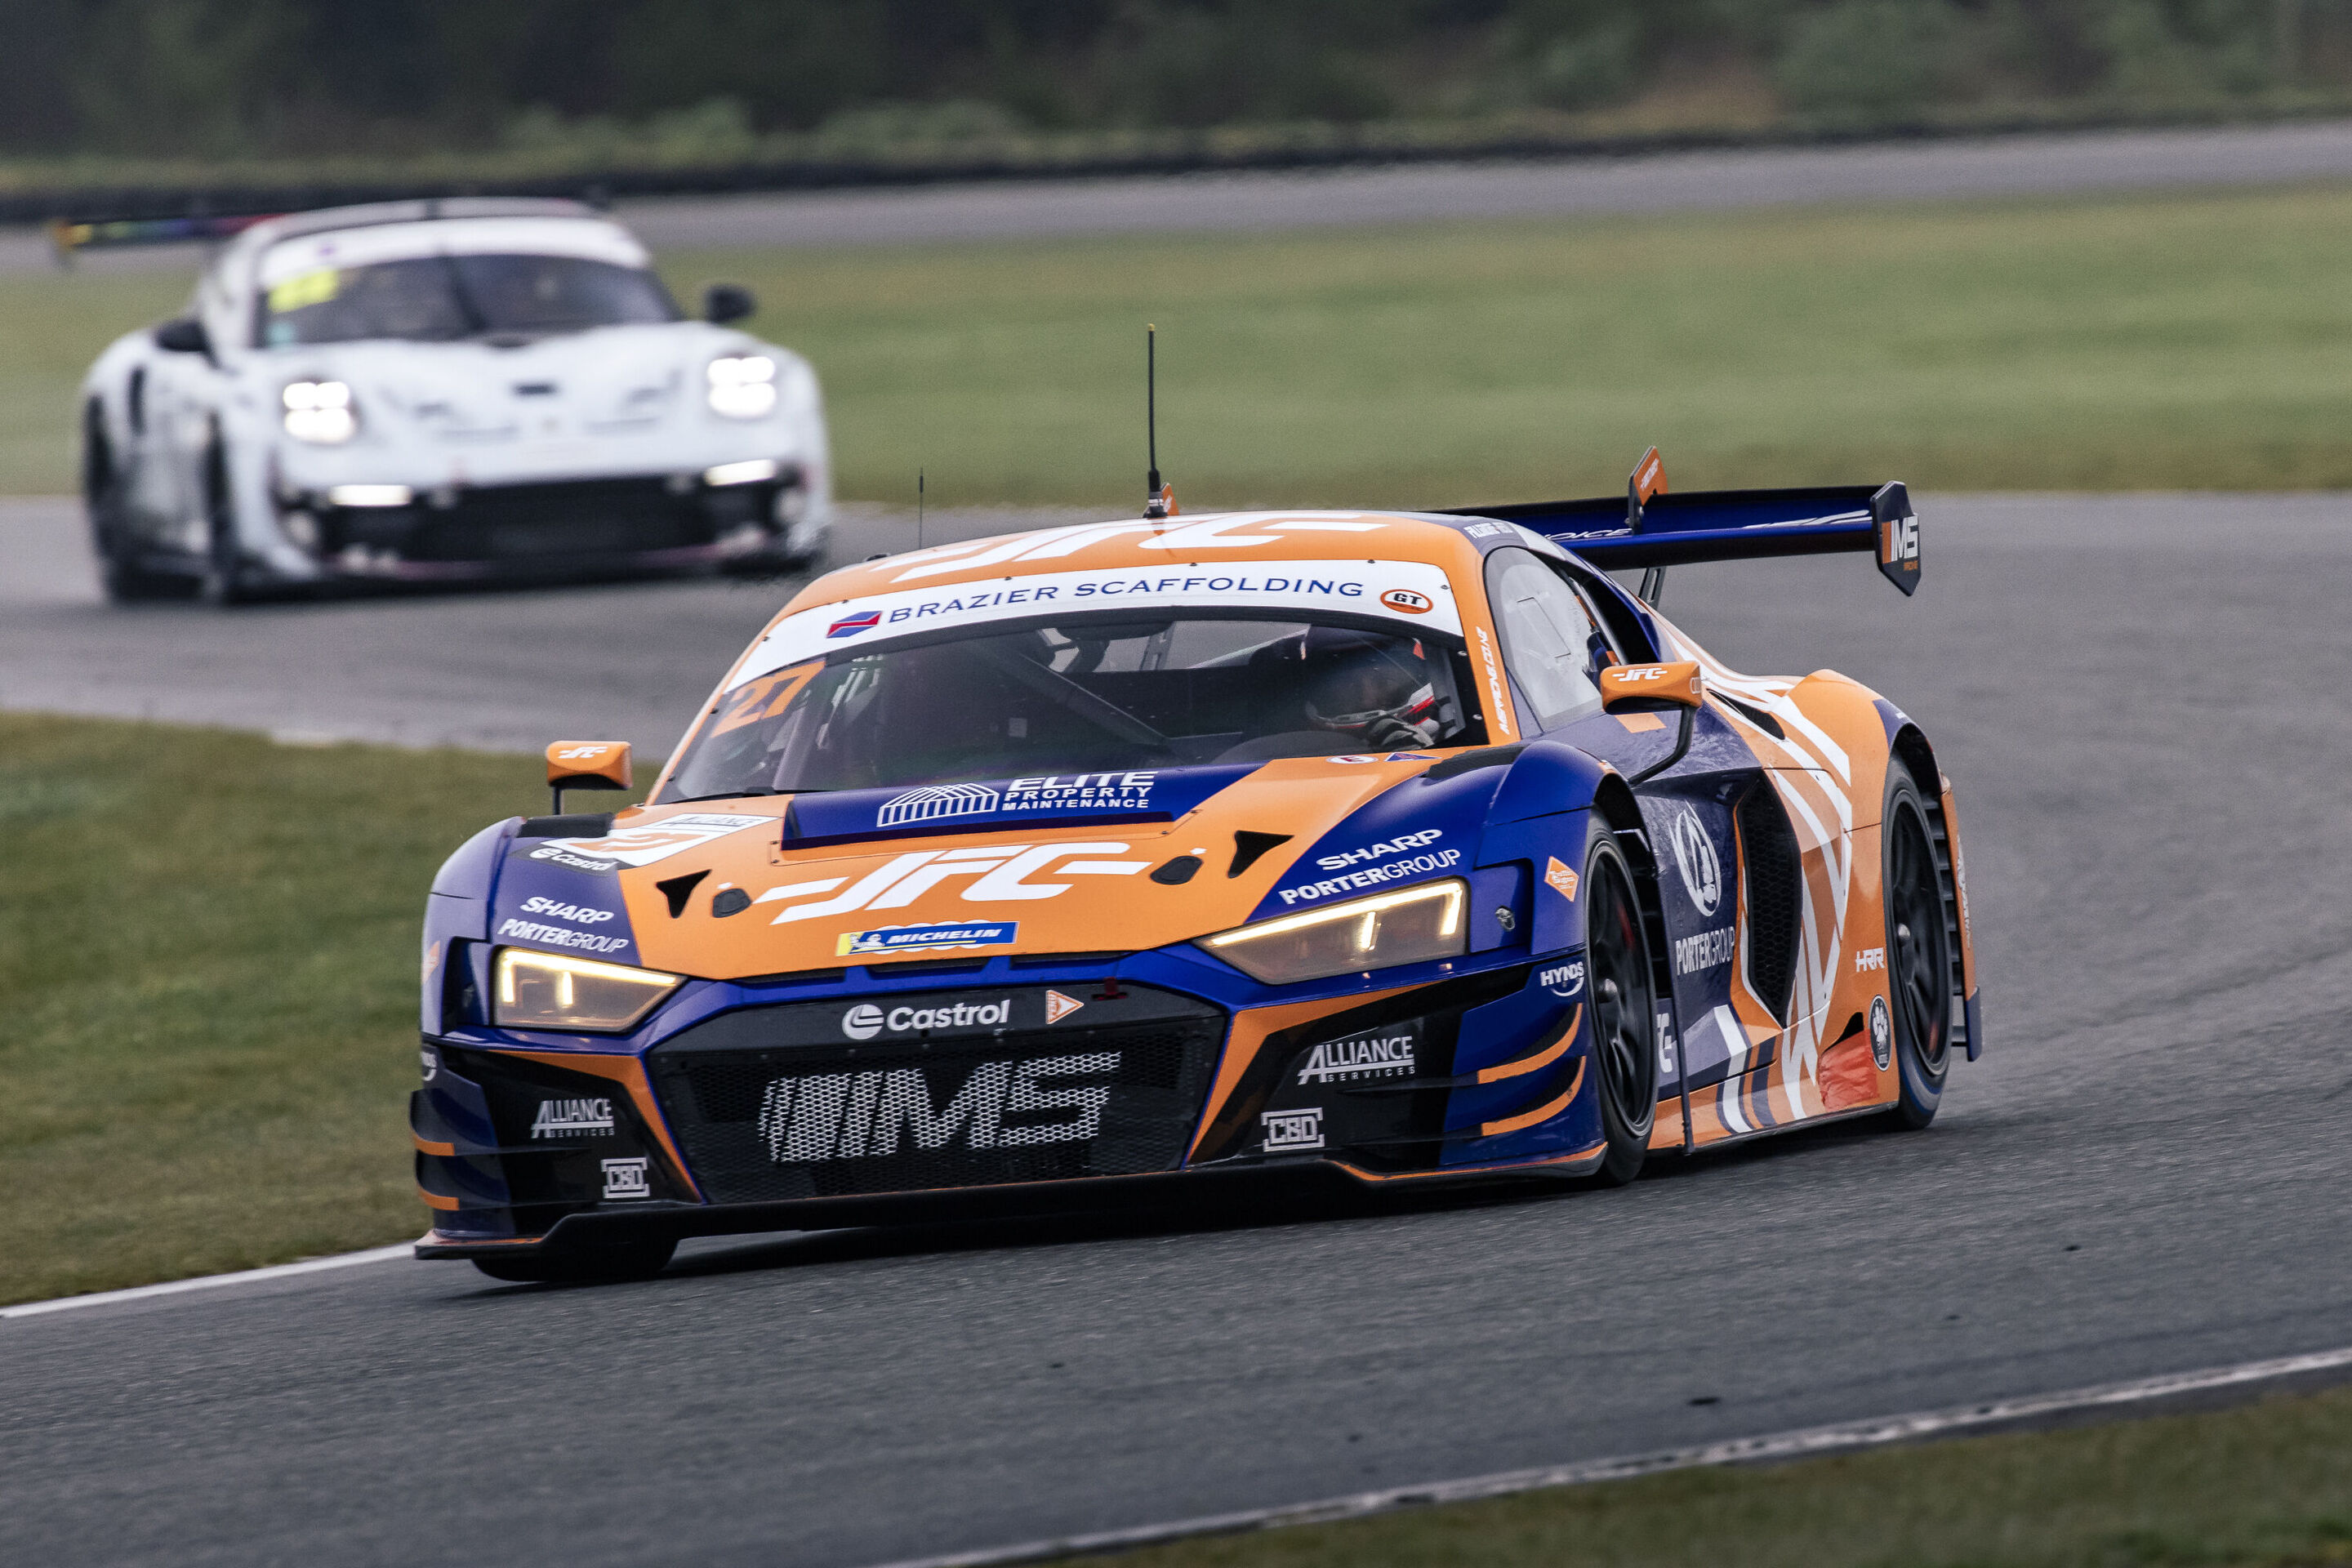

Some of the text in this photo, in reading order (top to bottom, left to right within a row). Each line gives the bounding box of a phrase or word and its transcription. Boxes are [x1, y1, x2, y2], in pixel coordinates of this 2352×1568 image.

[888, 577, 1365, 624] BRAZIER SCAFFOLDING
[1393, 593, 1423, 605] GT
[1611, 667, 1668, 682] JFC
[710, 661, 826, 738] 27
[1004, 786, 1153, 803] PROPERTY
[1007, 771, 1160, 792] ELITE
[1001, 798, 1150, 812] MAINTENANCE
[1316, 828, 1444, 871] SHARP
[752, 841, 1154, 926] JFC
[1277, 849, 1462, 905] PORTERGROUP
[519, 896, 615, 924] SHARP
[497, 918, 630, 954] PORTERGROUP
[885, 927, 1002, 945] MICHELIN
[1675, 925, 1736, 976] PORTERGROUP
[1539, 961, 1584, 987] HYNDS
[886, 999, 1011, 1032] Castrol
[1297, 1036, 1416, 1085] ALLIANCE
[1327, 1065, 1416, 1082] SERVICES
[531, 1098, 614, 1138] ALLIANCE
[1267, 1116, 1320, 1144] CBD
[606, 1165, 645, 1191] CBD
